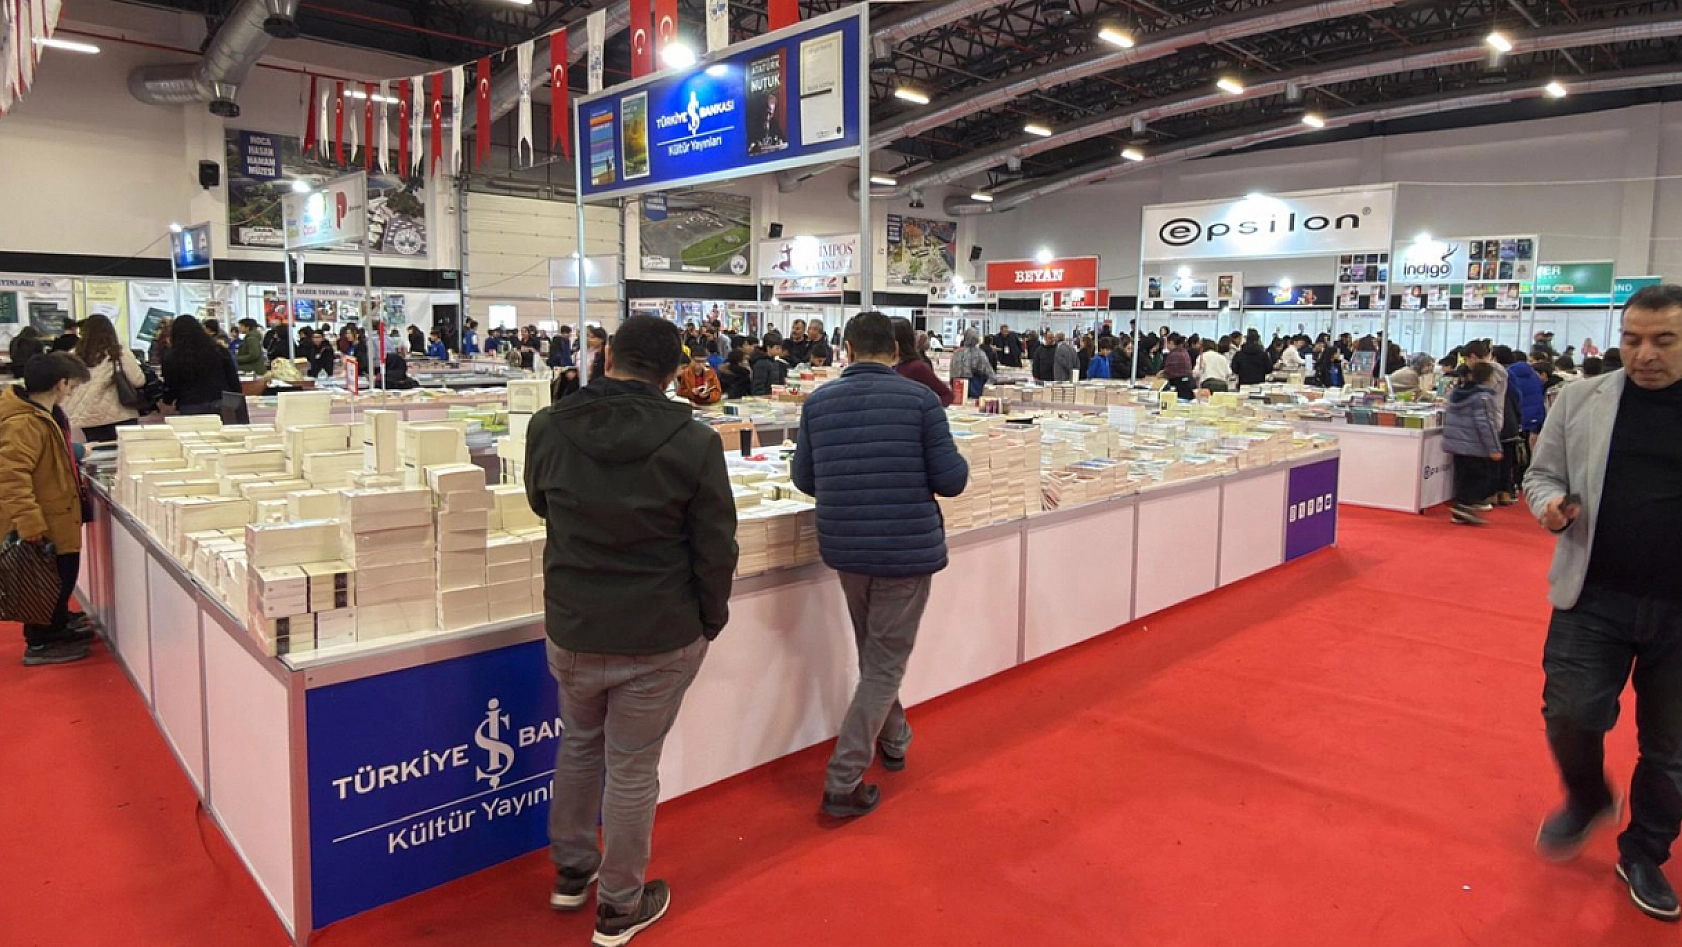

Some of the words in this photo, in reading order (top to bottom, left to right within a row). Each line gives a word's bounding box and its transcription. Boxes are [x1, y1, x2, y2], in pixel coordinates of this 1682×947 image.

[751, 73, 781, 93] NUTUK
[699, 99, 735, 119] BANKASI
[668, 141, 690, 157] Kültür
[1160, 213, 1361, 247] epsilon
[1014, 268, 1065, 284] BEYAN
[332, 743, 470, 801] TÜRKİYE
[518, 717, 567, 748] BAN
[387, 809, 477, 854] Kültür
[480, 780, 555, 821] Yayınl
